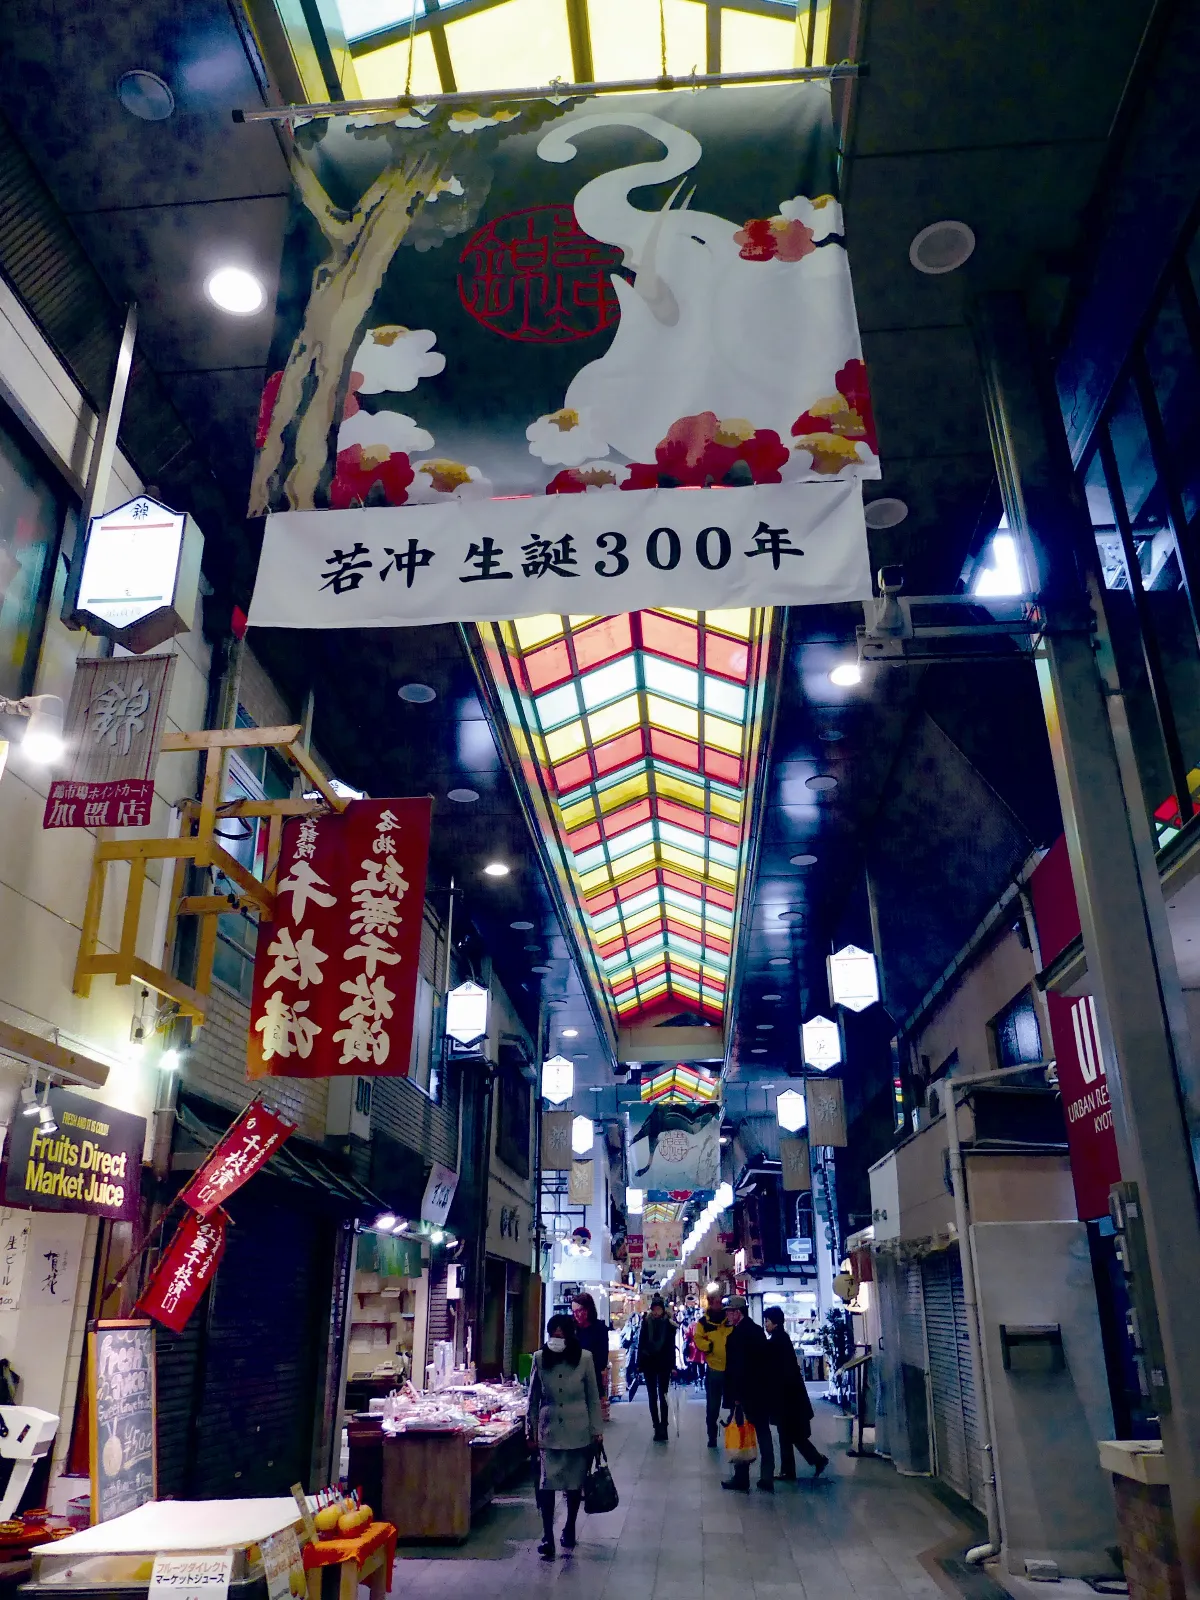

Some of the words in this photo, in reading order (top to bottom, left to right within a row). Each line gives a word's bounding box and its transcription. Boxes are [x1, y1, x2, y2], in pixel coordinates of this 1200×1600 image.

[319, 539, 435, 594] 若冲
[459, 521, 804, 582] 生誕300年
[91, 678, 150, 756] 錦
[47, 799, 147, 827] 加盟店
[1067, 1091, 1096, 1123] URBAN
[29, 1127, 79, 1167] Fruits
[79, 1140, 127, 1178] Direct
[25, 1160, 84, 1200] Market
[84, 1173, 125, 1207] Juice
[155, 1573, 225, 1585] マーケットジュース
[157, 1562, 229, 1574] フルーツダイレクト
